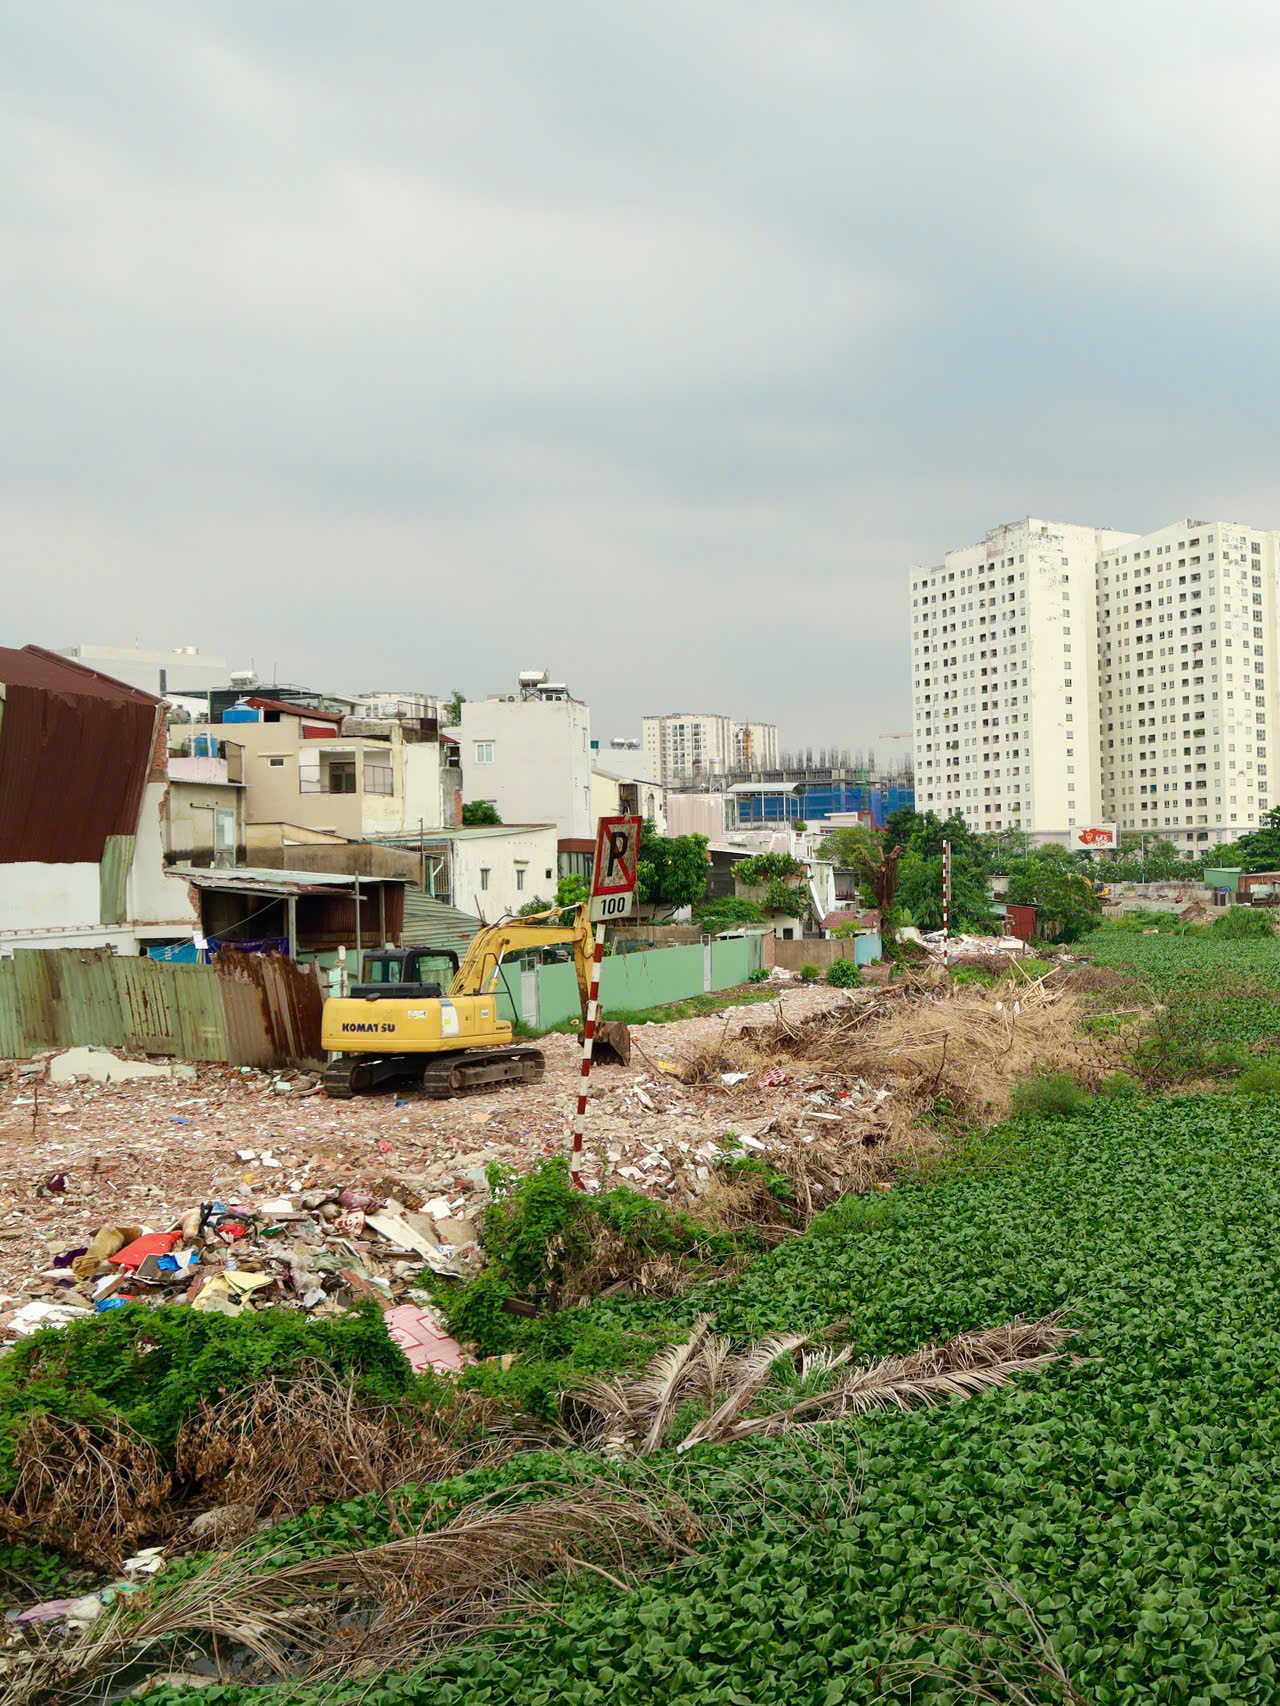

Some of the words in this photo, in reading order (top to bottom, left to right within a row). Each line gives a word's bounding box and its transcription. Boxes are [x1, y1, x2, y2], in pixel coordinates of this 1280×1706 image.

[607, 831, 628, 877] P
[600, 896, 626, 916] 100
[342, 1023, 396, 1033] KOMATSU
